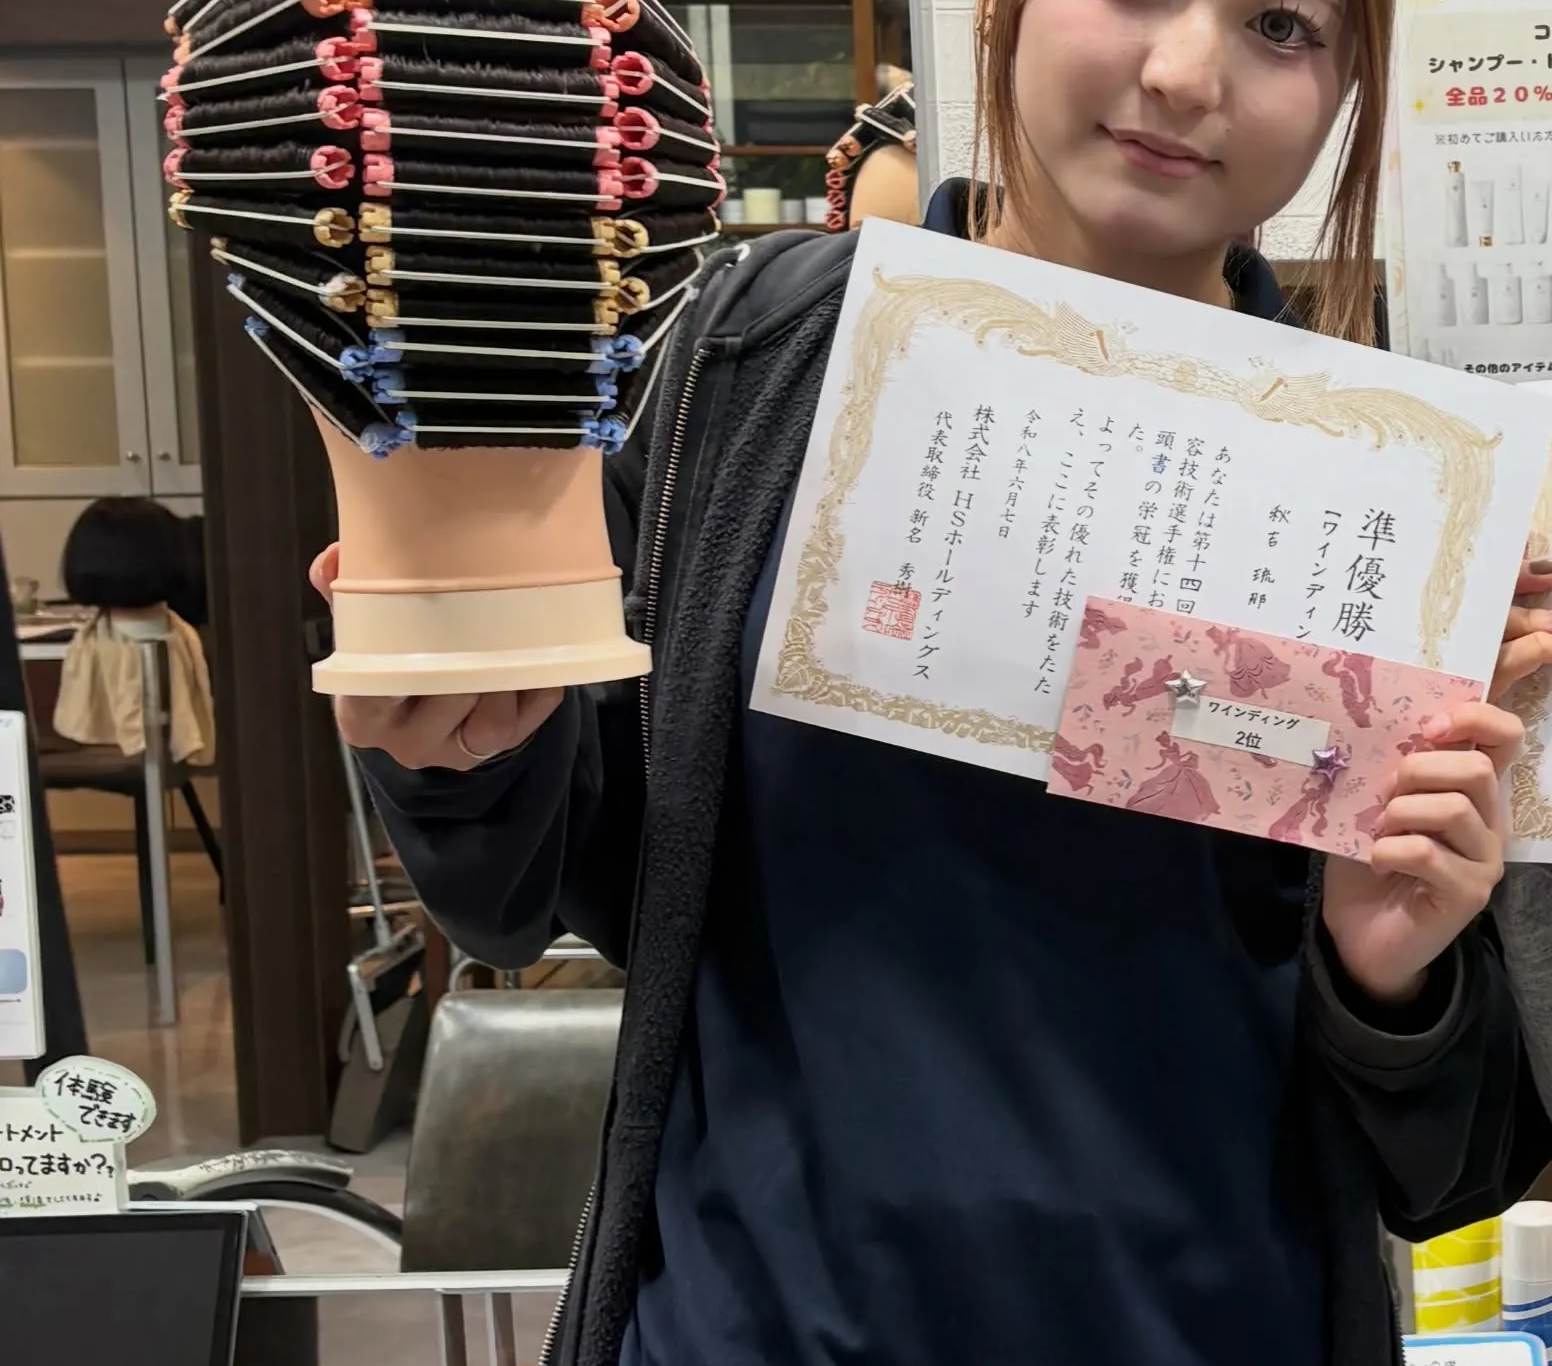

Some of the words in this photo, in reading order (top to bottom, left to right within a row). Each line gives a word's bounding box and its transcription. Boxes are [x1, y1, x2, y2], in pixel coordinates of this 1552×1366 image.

[998, 409, 1042, 539] 令和八年六月七日
[1332, 508, 1397, 642] 準優勝
[1208, 701, 1300, 730] ワインディング
[1234, 730, 1263, 749] 2位
[54, 1071, 118, 1104] 体験
[79, 1104, 137, 1133] できます
